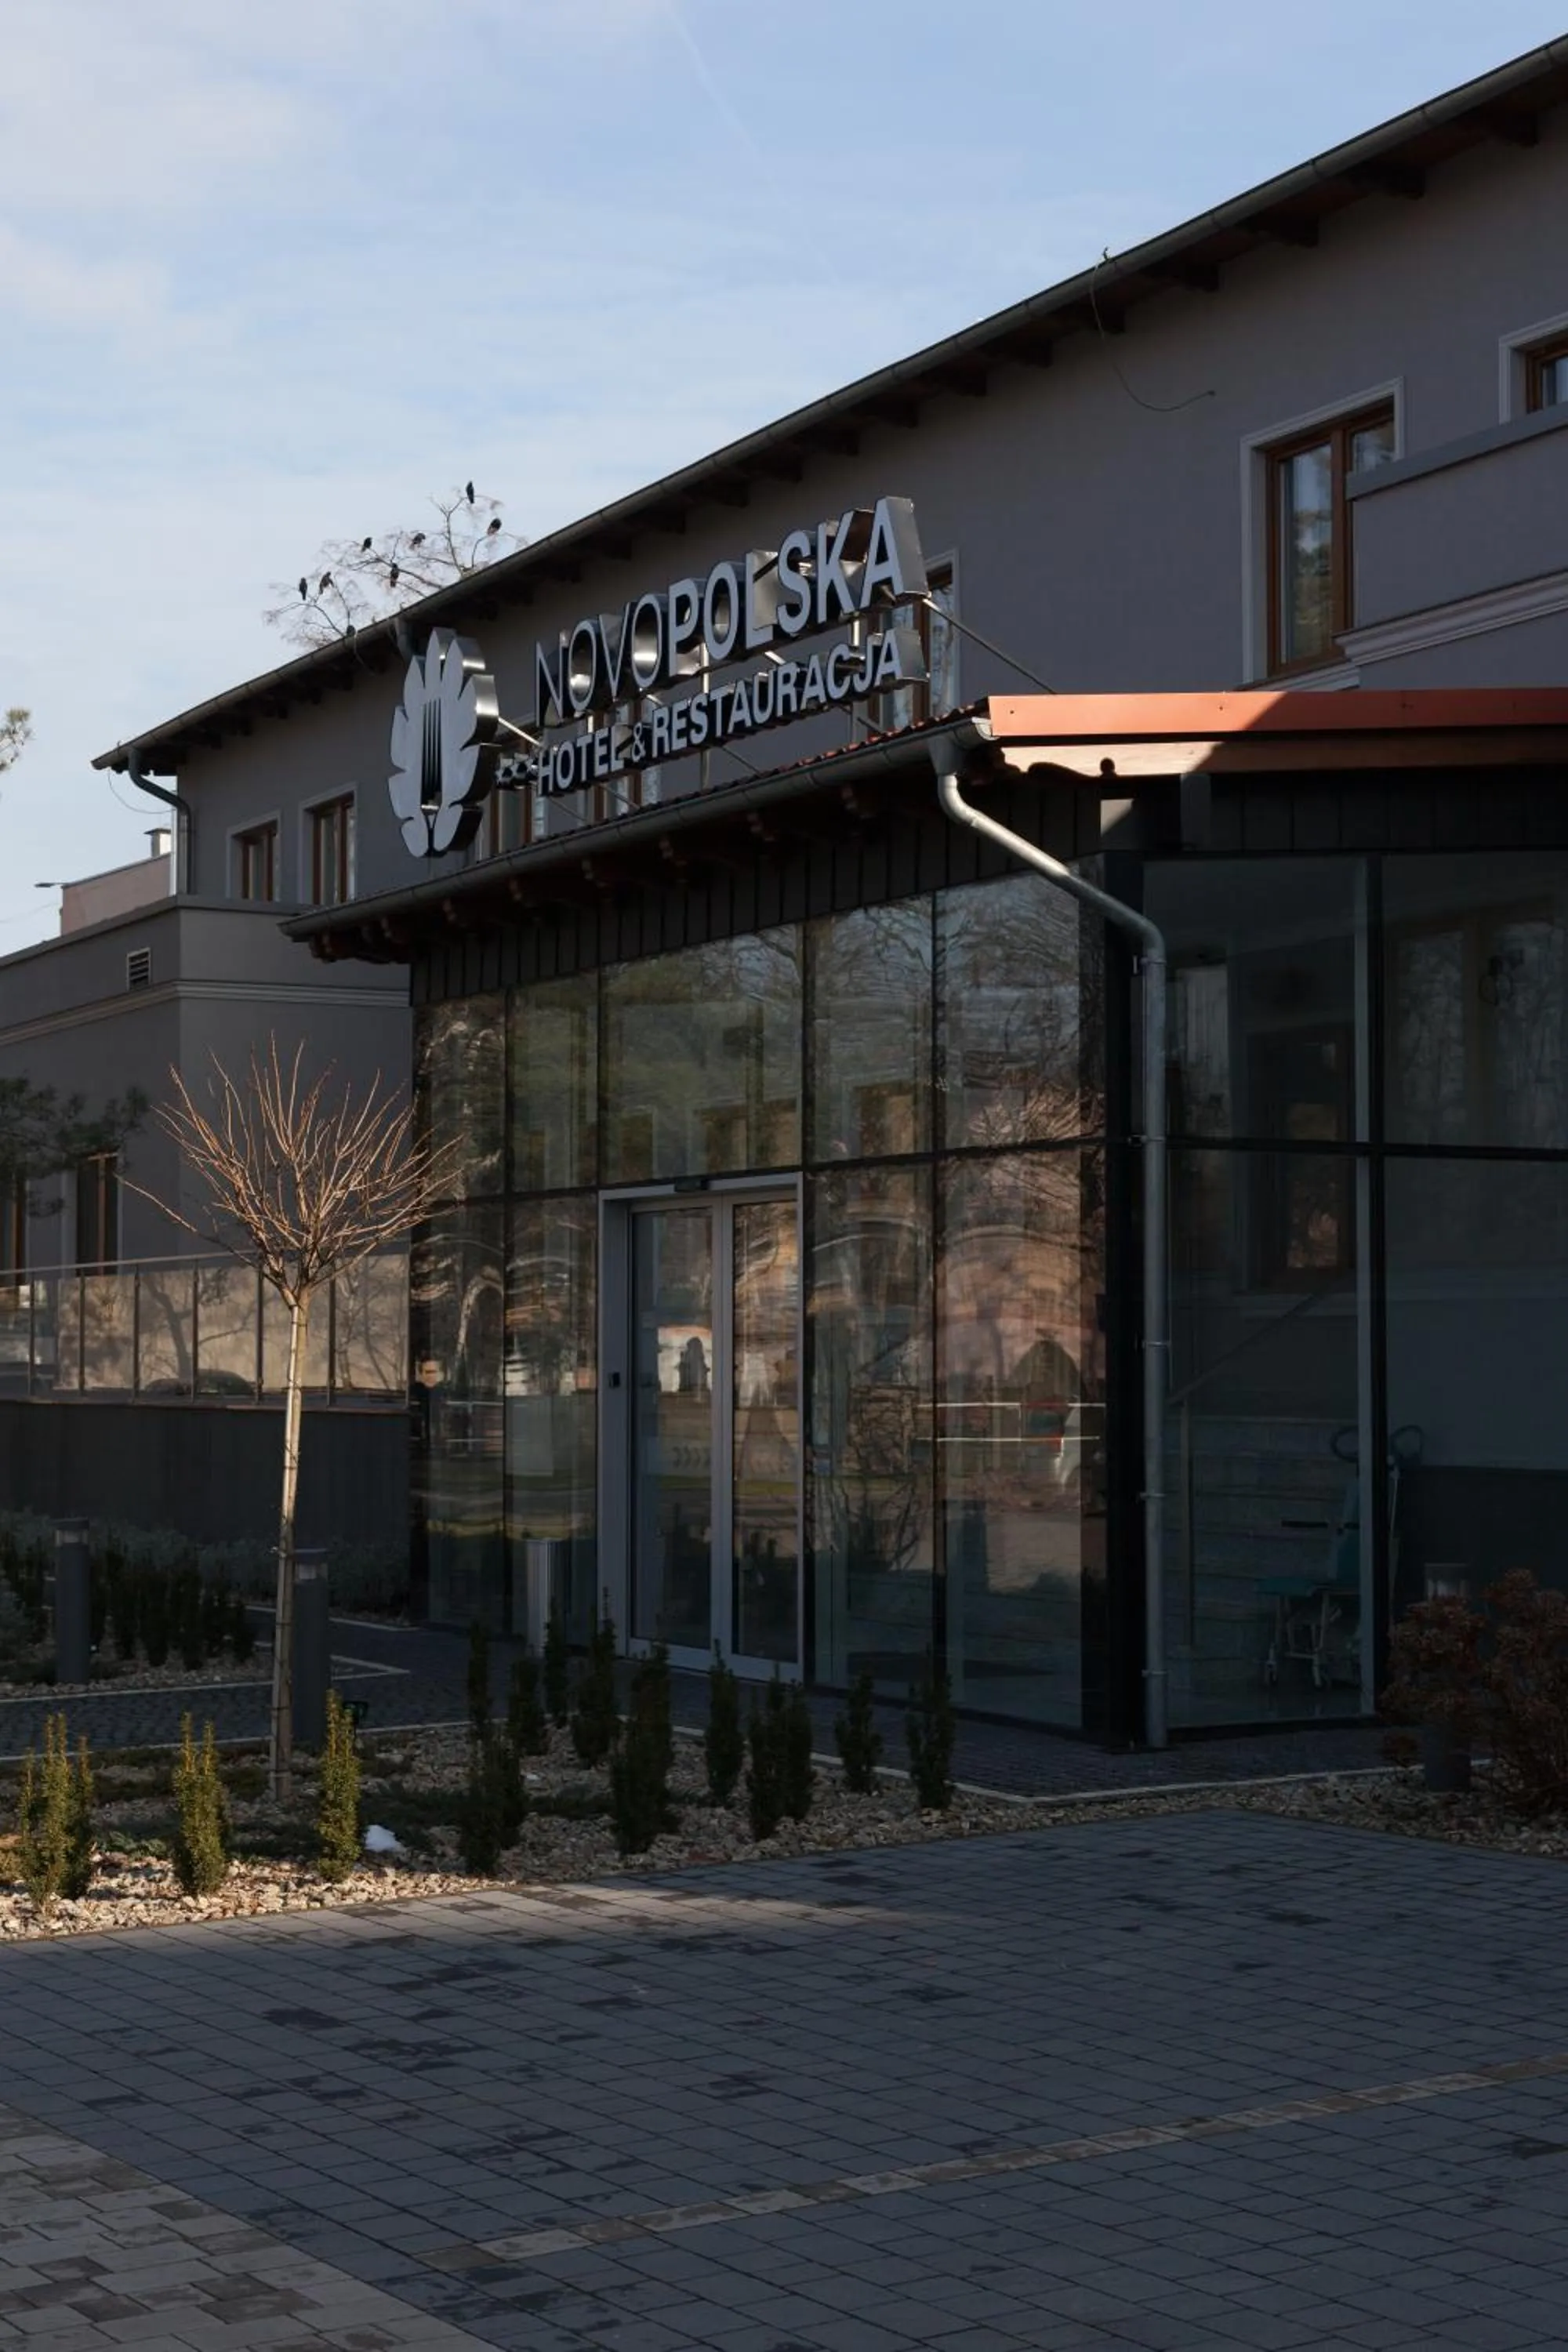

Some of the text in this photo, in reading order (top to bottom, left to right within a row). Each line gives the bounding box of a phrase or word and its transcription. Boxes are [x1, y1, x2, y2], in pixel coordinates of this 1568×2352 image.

[535, 496, 906, 727] NOVOPOLSKA
[538, 628, 903, 796] HOTEL & RESTAURACJA
